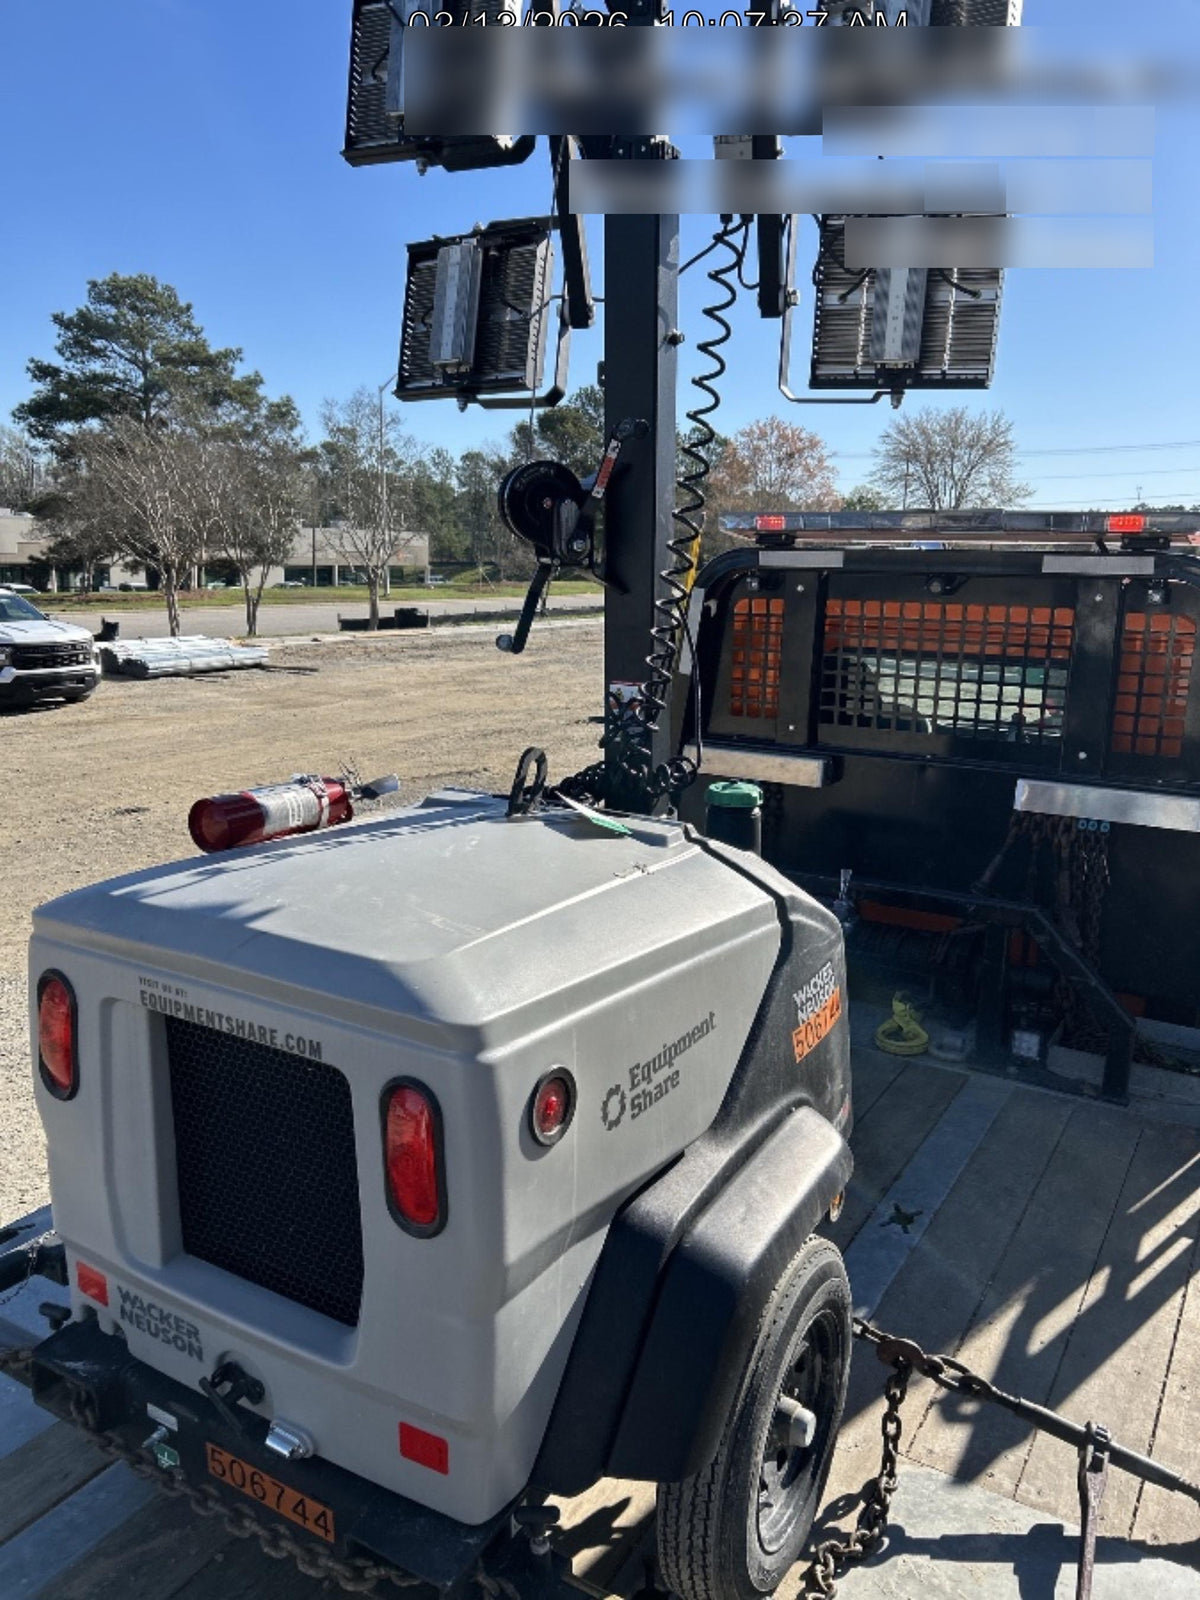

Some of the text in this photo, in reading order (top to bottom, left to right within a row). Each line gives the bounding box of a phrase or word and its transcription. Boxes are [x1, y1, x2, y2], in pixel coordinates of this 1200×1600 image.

[139, 989, 323, 1060] EQUIPMENTSHARE.COM
[628, 1010, 717, 1092] Equipment
[630, 1069, 680, 1120] Share
[116, 1284, 200, 1343] WACKER
[119, 1304, 204, 1362] NEUSON
[210, 1446, 332, 1538] 506744
